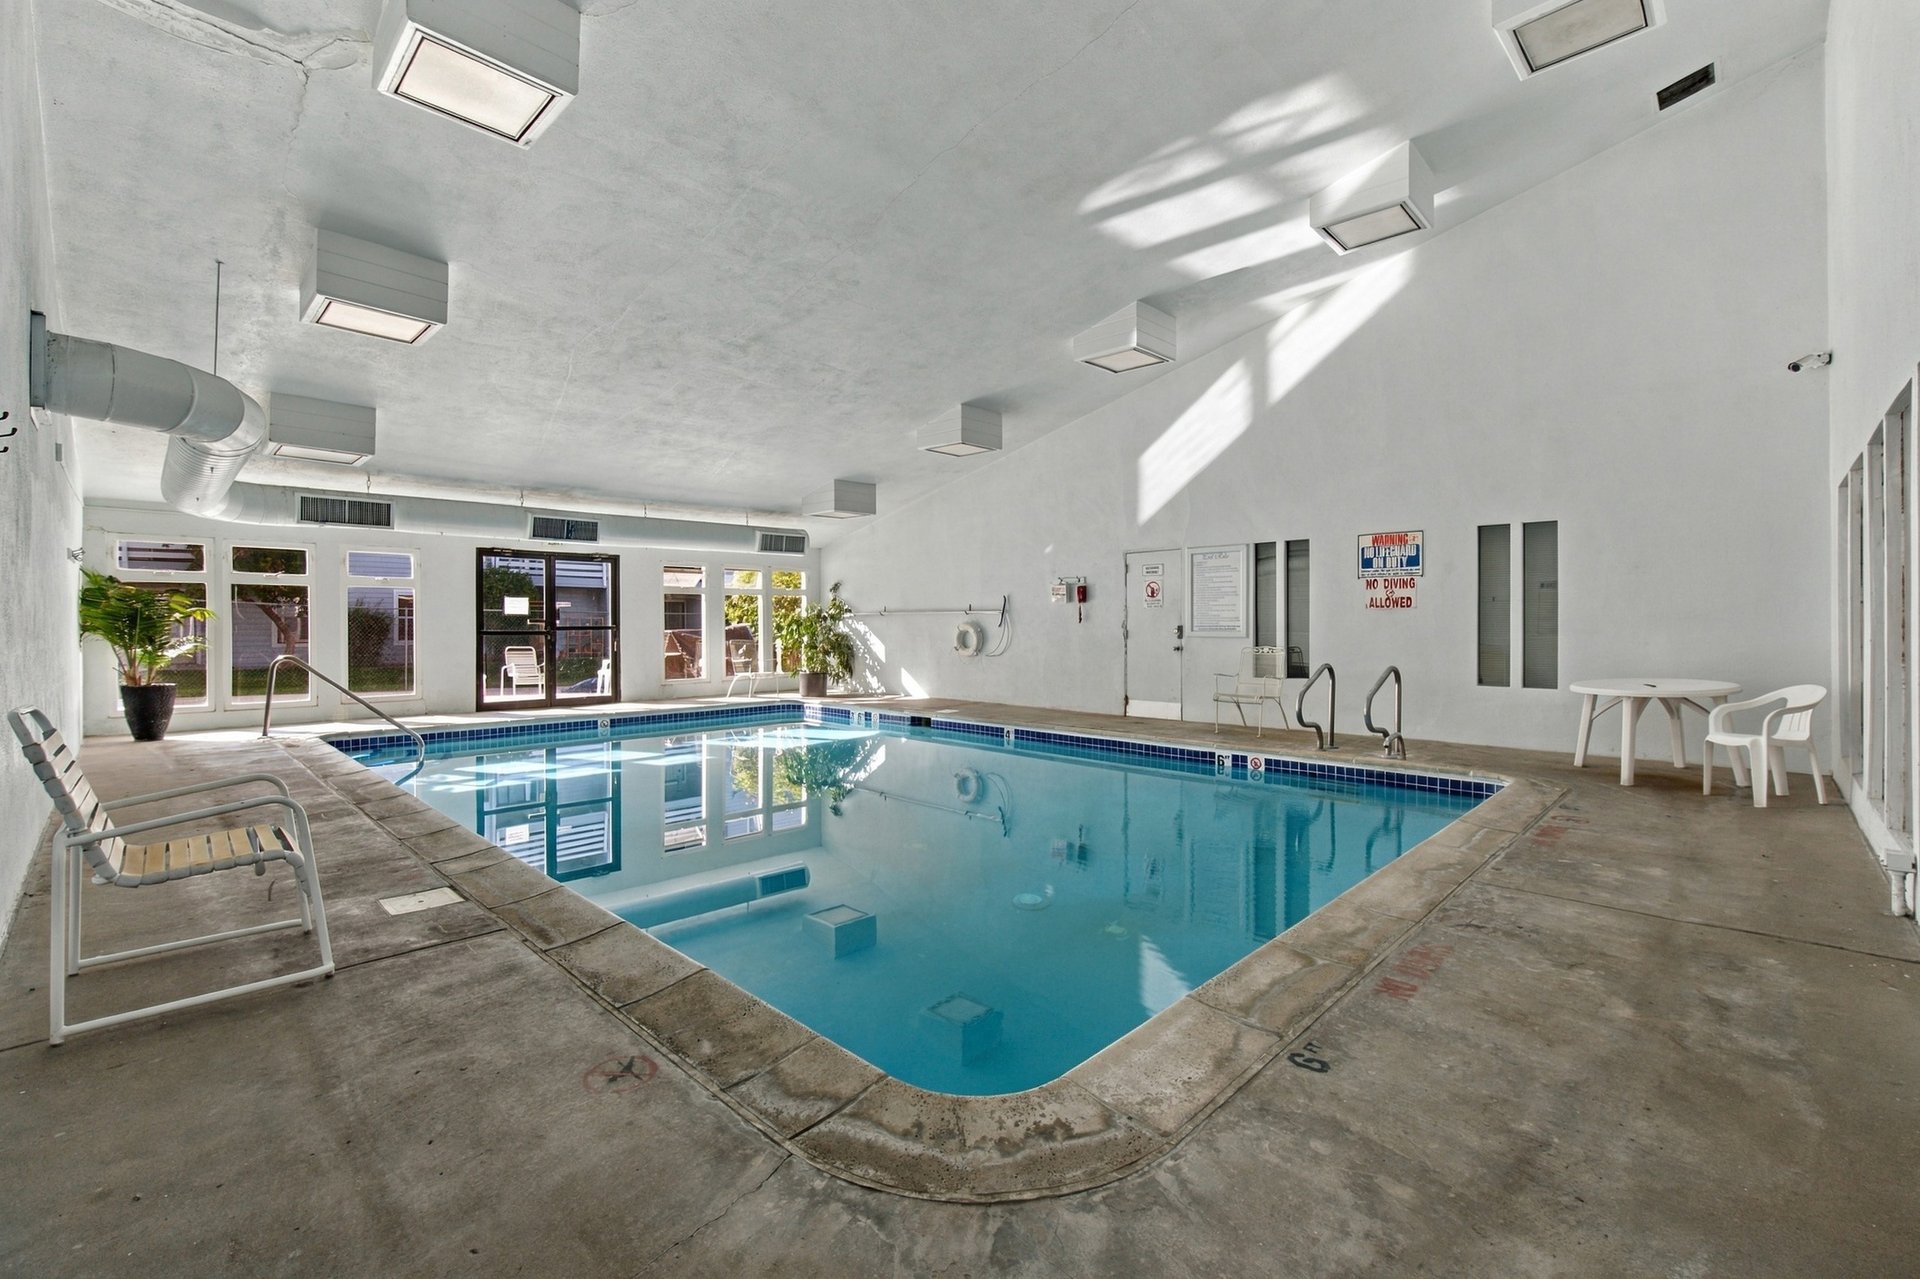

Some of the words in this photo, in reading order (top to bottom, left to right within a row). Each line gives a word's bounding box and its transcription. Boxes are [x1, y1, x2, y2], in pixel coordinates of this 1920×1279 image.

[1372, 534, 1409, 546] WARNING
[1364, 546, 1375, 558] NO
[1373, 557, 1384, 568] ON
[1386, 556, 1408, 568] DUTY
[1366, 579, 1379, 590] NO
[1384, 578, 1416, 590] DIVING
[1369, 597, 1413, 609] ALLOWED
